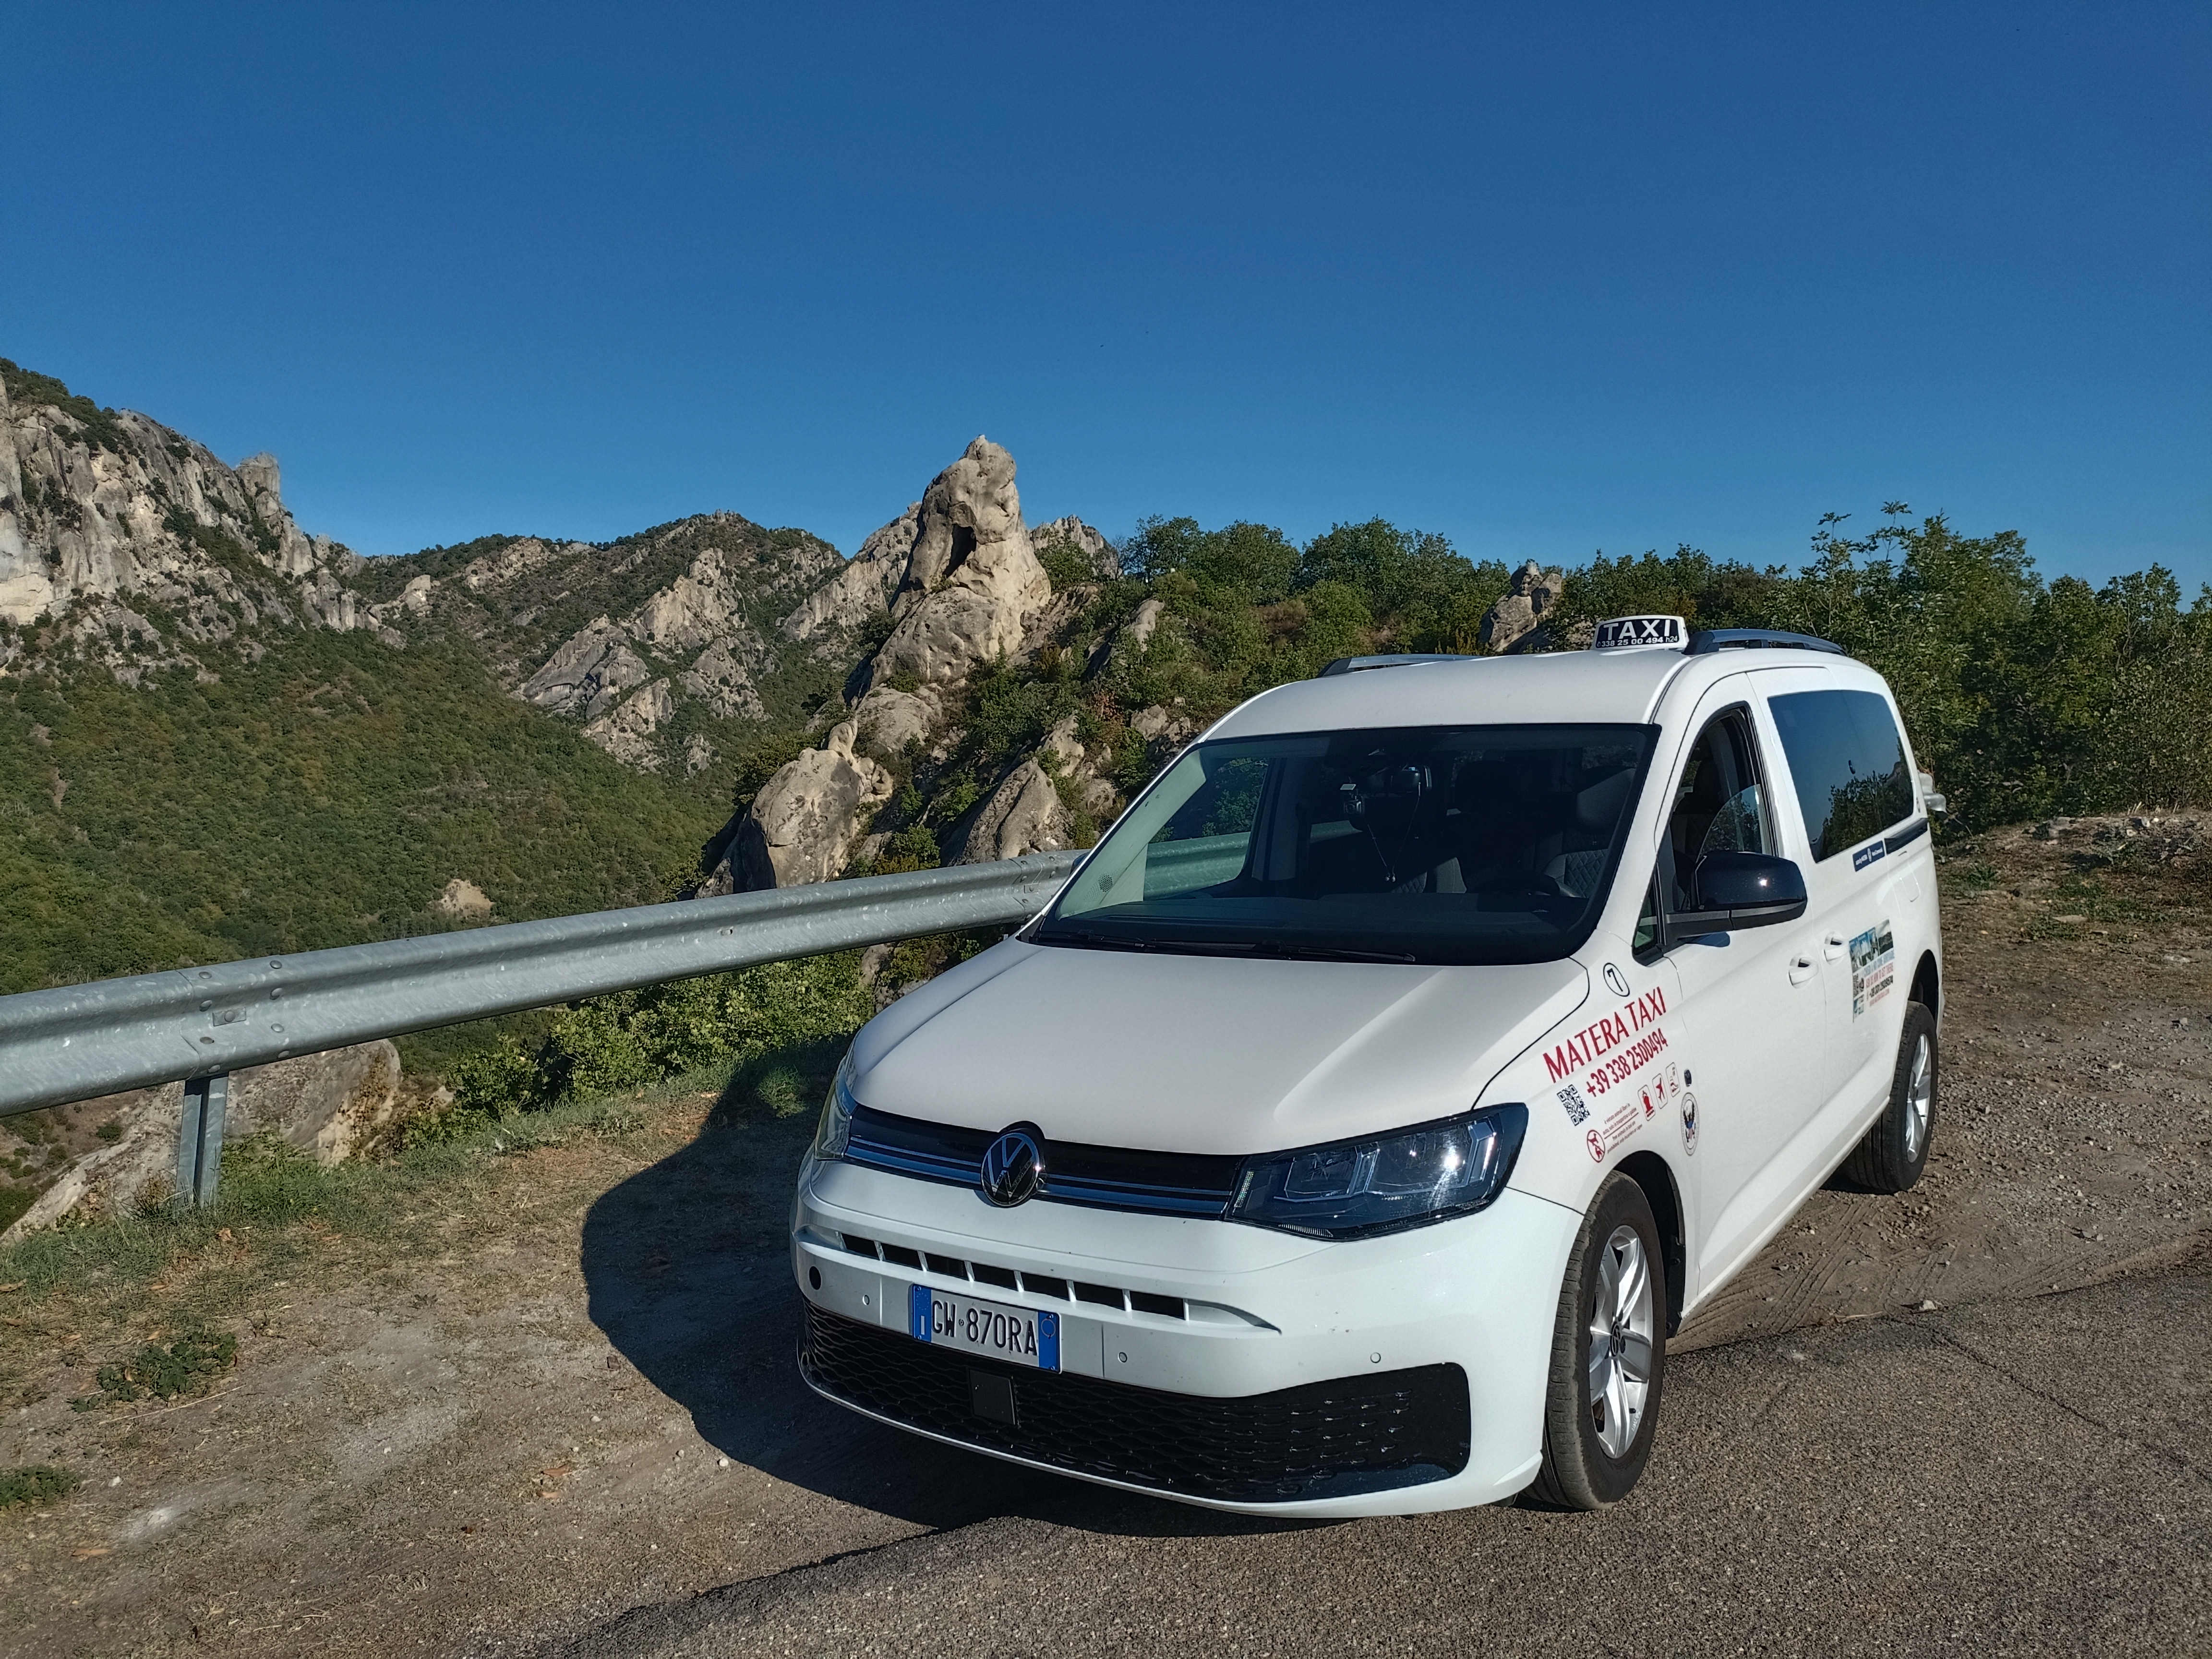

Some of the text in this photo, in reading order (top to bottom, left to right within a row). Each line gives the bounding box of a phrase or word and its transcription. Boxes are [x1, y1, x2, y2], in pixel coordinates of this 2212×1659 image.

[1603, 620, 1670, 640] TAXI
[1607, 968, 1623, 992] 7
[1542, 986, 1667, 1083] MATERA TAXI
[1586, 1028, 1668, 1098] +39 338 2500494
[932, 1300, 1037, 1356] GW 870RA
